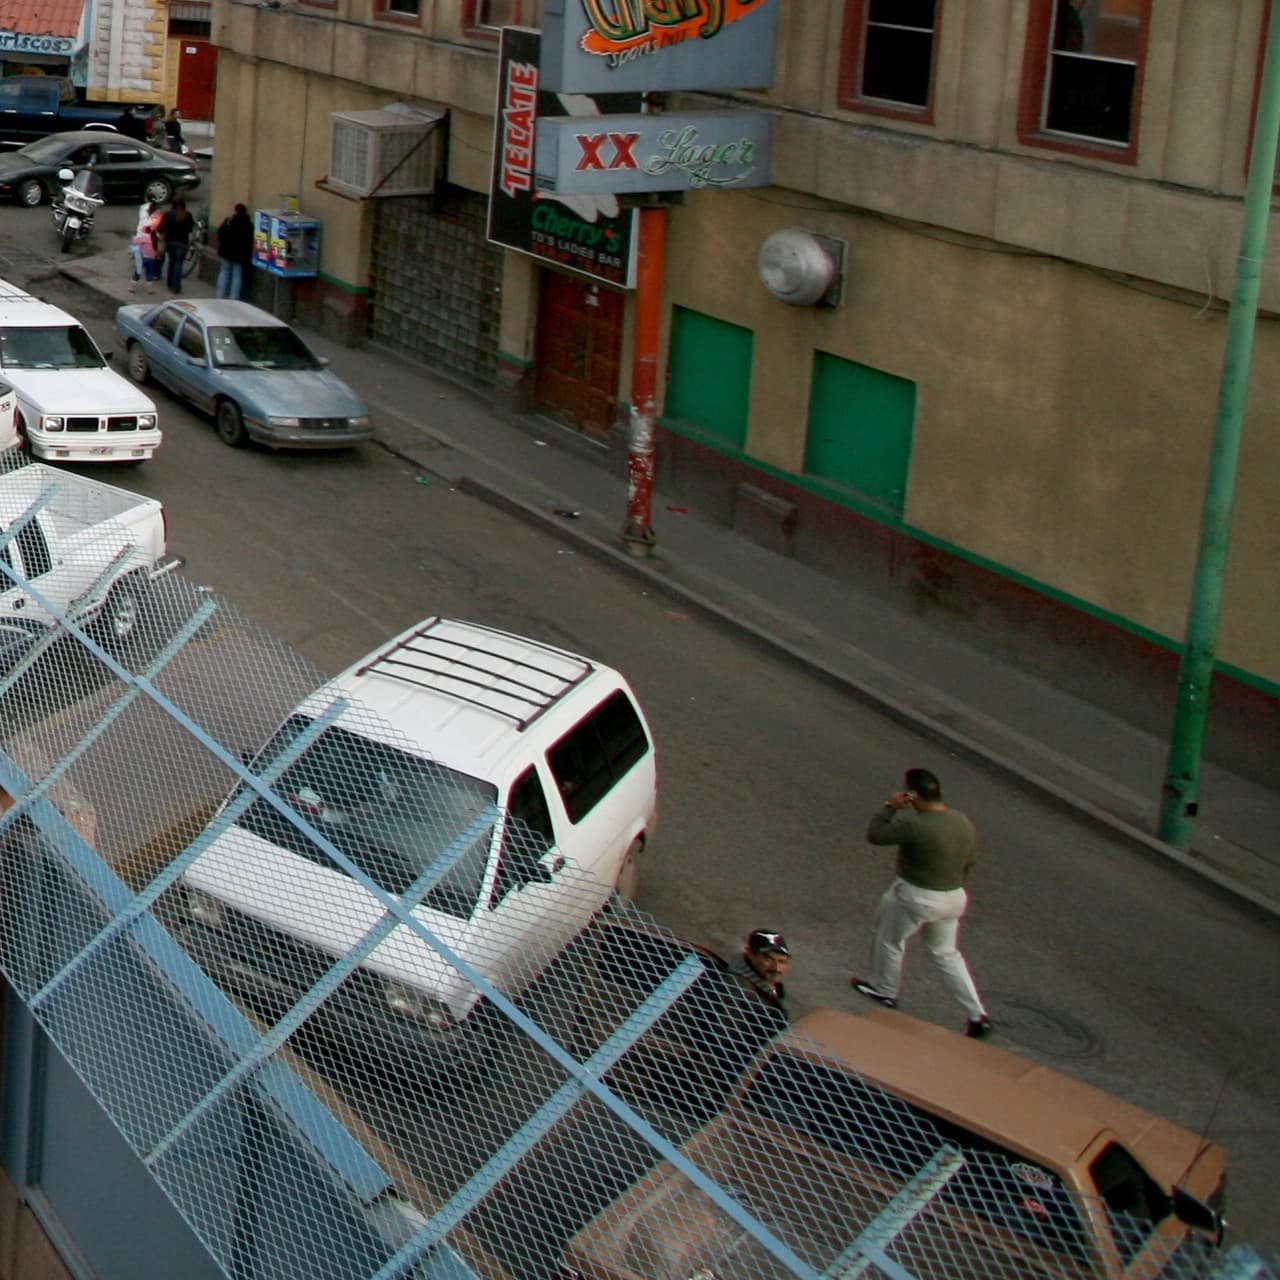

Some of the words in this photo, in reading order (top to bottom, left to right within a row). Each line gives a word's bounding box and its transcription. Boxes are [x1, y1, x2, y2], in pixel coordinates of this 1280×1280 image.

[606, 36, 658, 70] sports
[501, 60, 538, 198] TECATE
[575, 132, 640, 171] XX
[646, 125, 755, 188] Lager
[558, 239, 595, 260] LADIES
[597, 253, 622, 268] BAR
